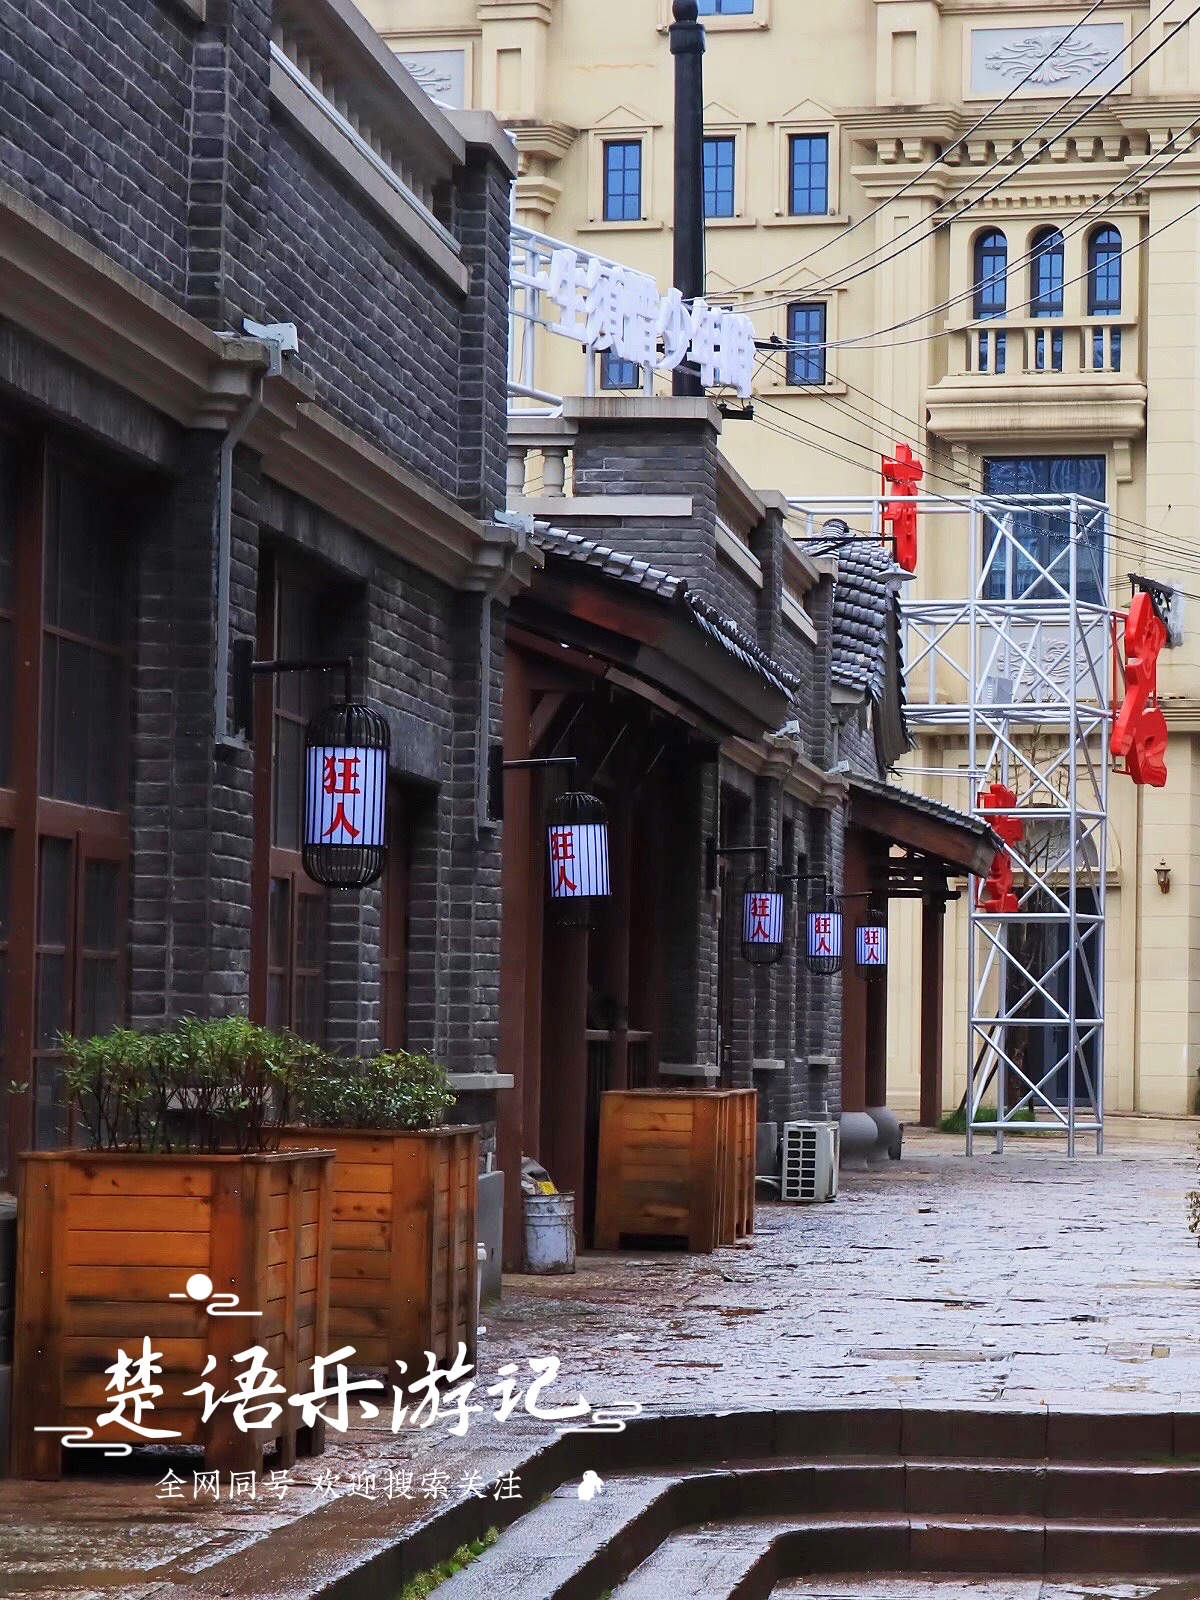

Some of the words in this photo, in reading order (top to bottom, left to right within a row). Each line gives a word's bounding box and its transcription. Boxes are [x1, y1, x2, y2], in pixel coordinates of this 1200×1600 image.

[323, 755, 361, 838] 狂人
[551, 831, 577, 891] 狂人
[751, 897, 770, 939] 狂人
[815, 916, 831, 953] 狂人
[864, 930, 880, 962] 狂人
